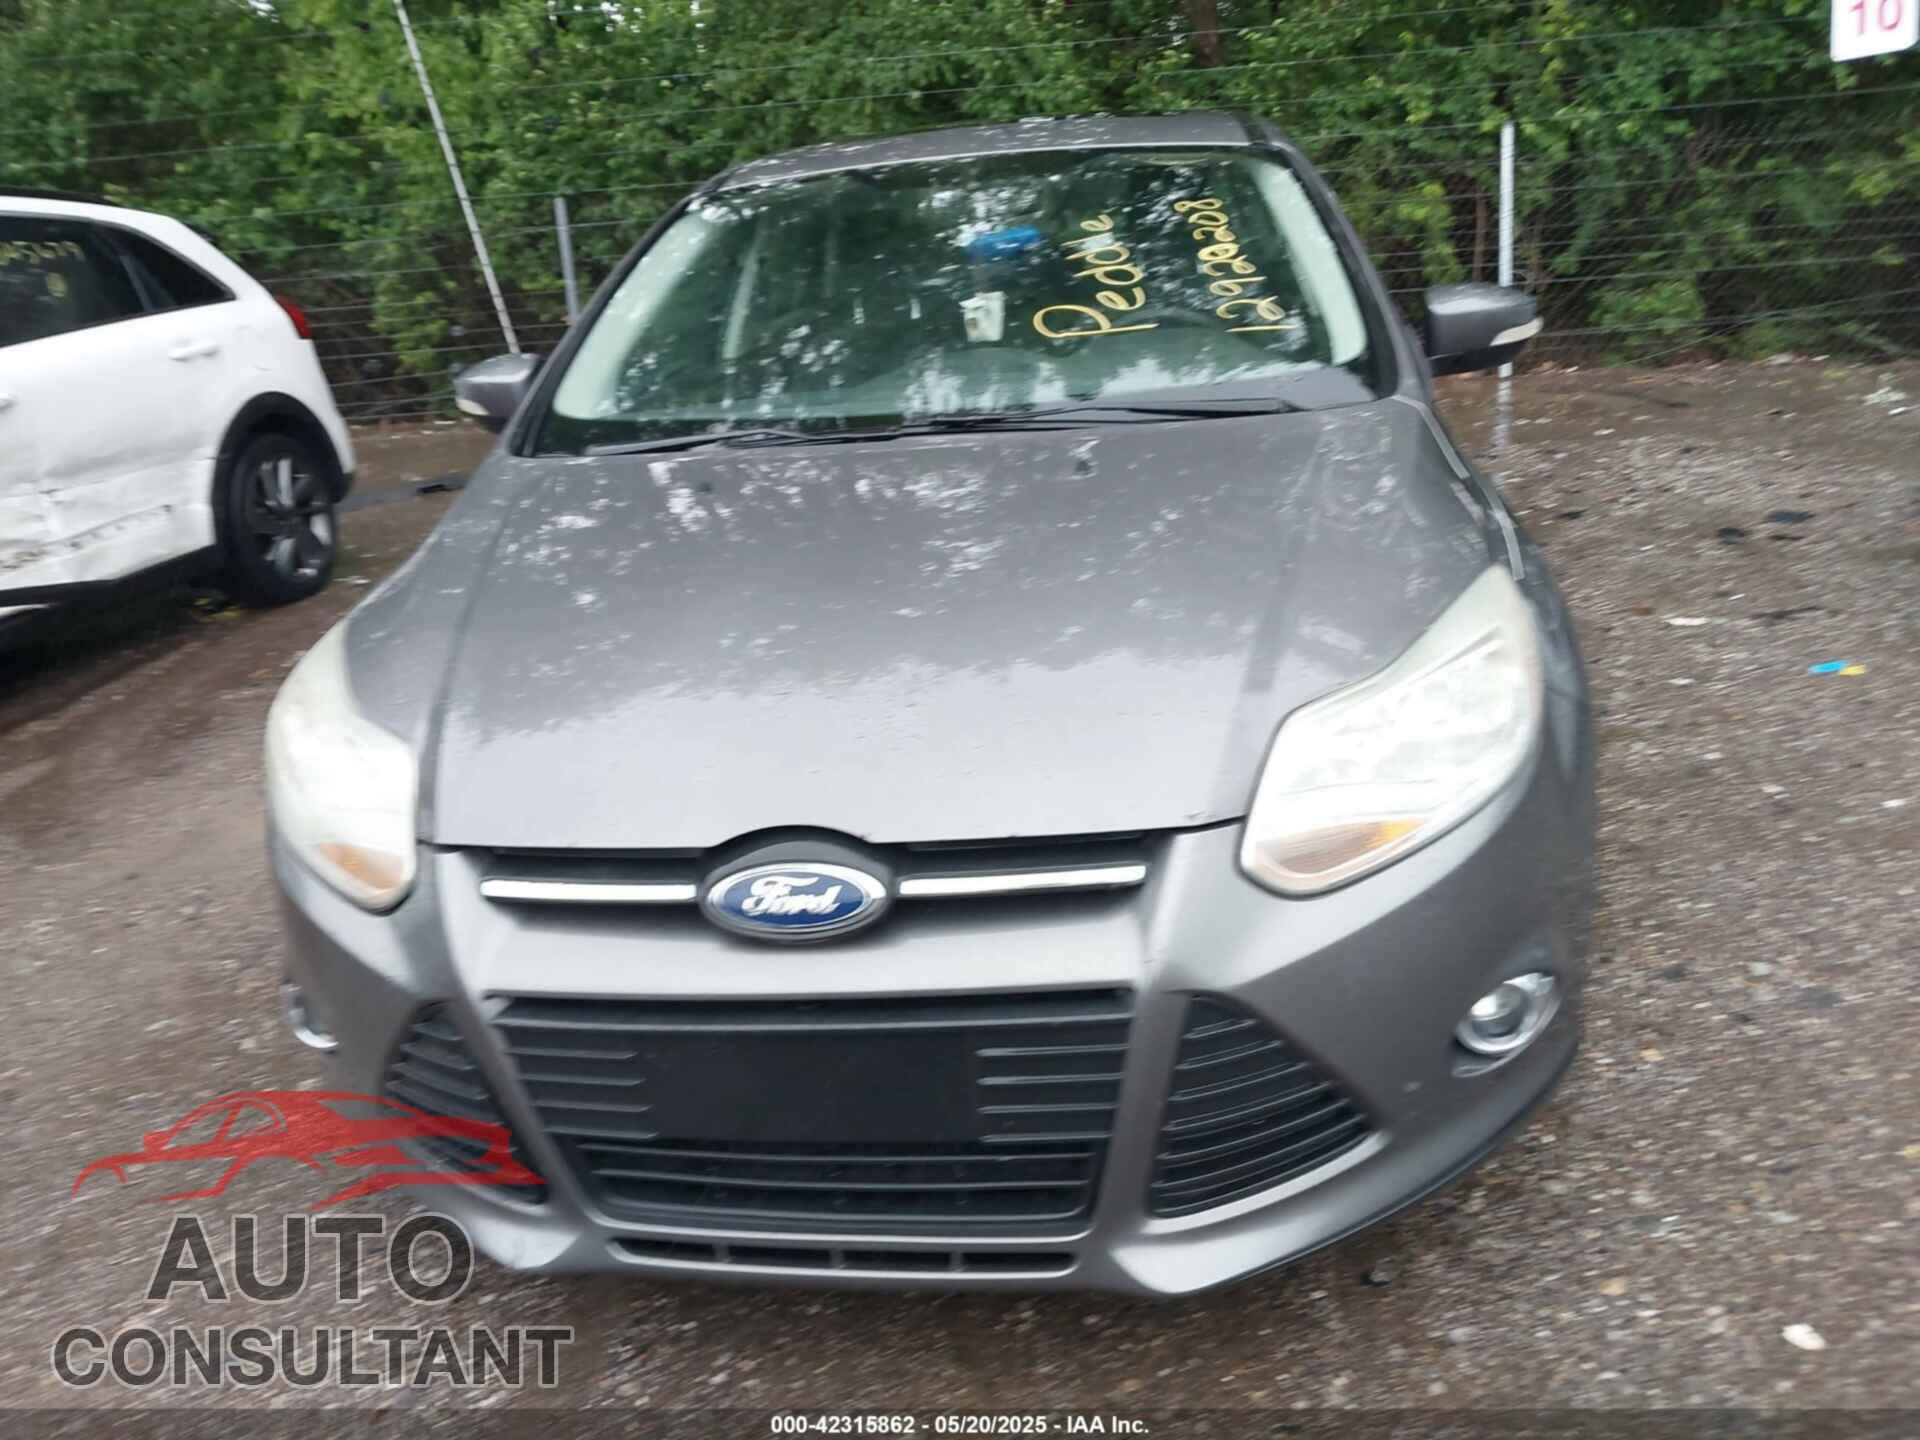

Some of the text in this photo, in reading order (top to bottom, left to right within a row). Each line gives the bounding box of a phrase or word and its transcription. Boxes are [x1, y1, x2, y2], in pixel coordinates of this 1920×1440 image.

[1850, 0, 1904, 35] 10
[1033, 214, 1159, 338] Peddle
[1174, 198, 1299, 333] 12920208
[741, 875, 843, 916] Ford
